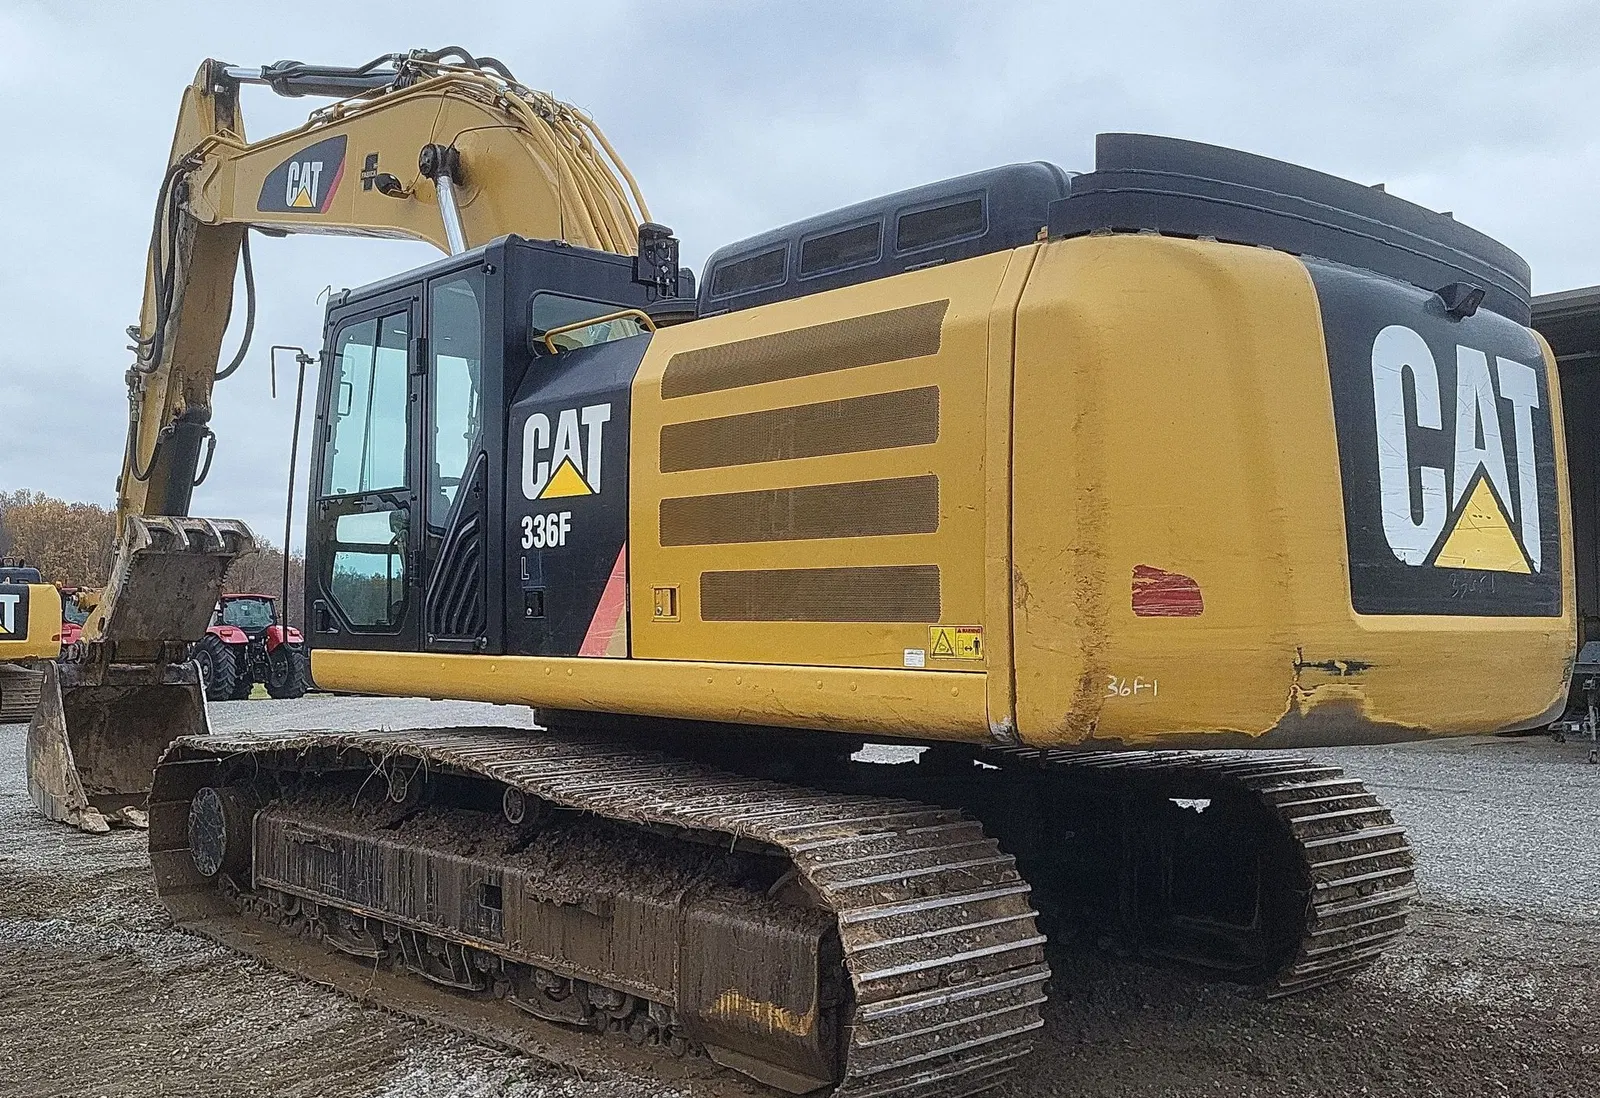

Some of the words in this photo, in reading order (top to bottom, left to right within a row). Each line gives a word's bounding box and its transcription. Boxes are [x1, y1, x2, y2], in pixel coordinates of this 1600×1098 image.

[285, 161, 324, 208] CAT
[521, 403, 611, 500] CAT
[1372, 324, 1542, 574] CAT
[521, 511, 572, 550] 336F
[521, 556, 530, 580] L
[0, 594, 20, 634] T
